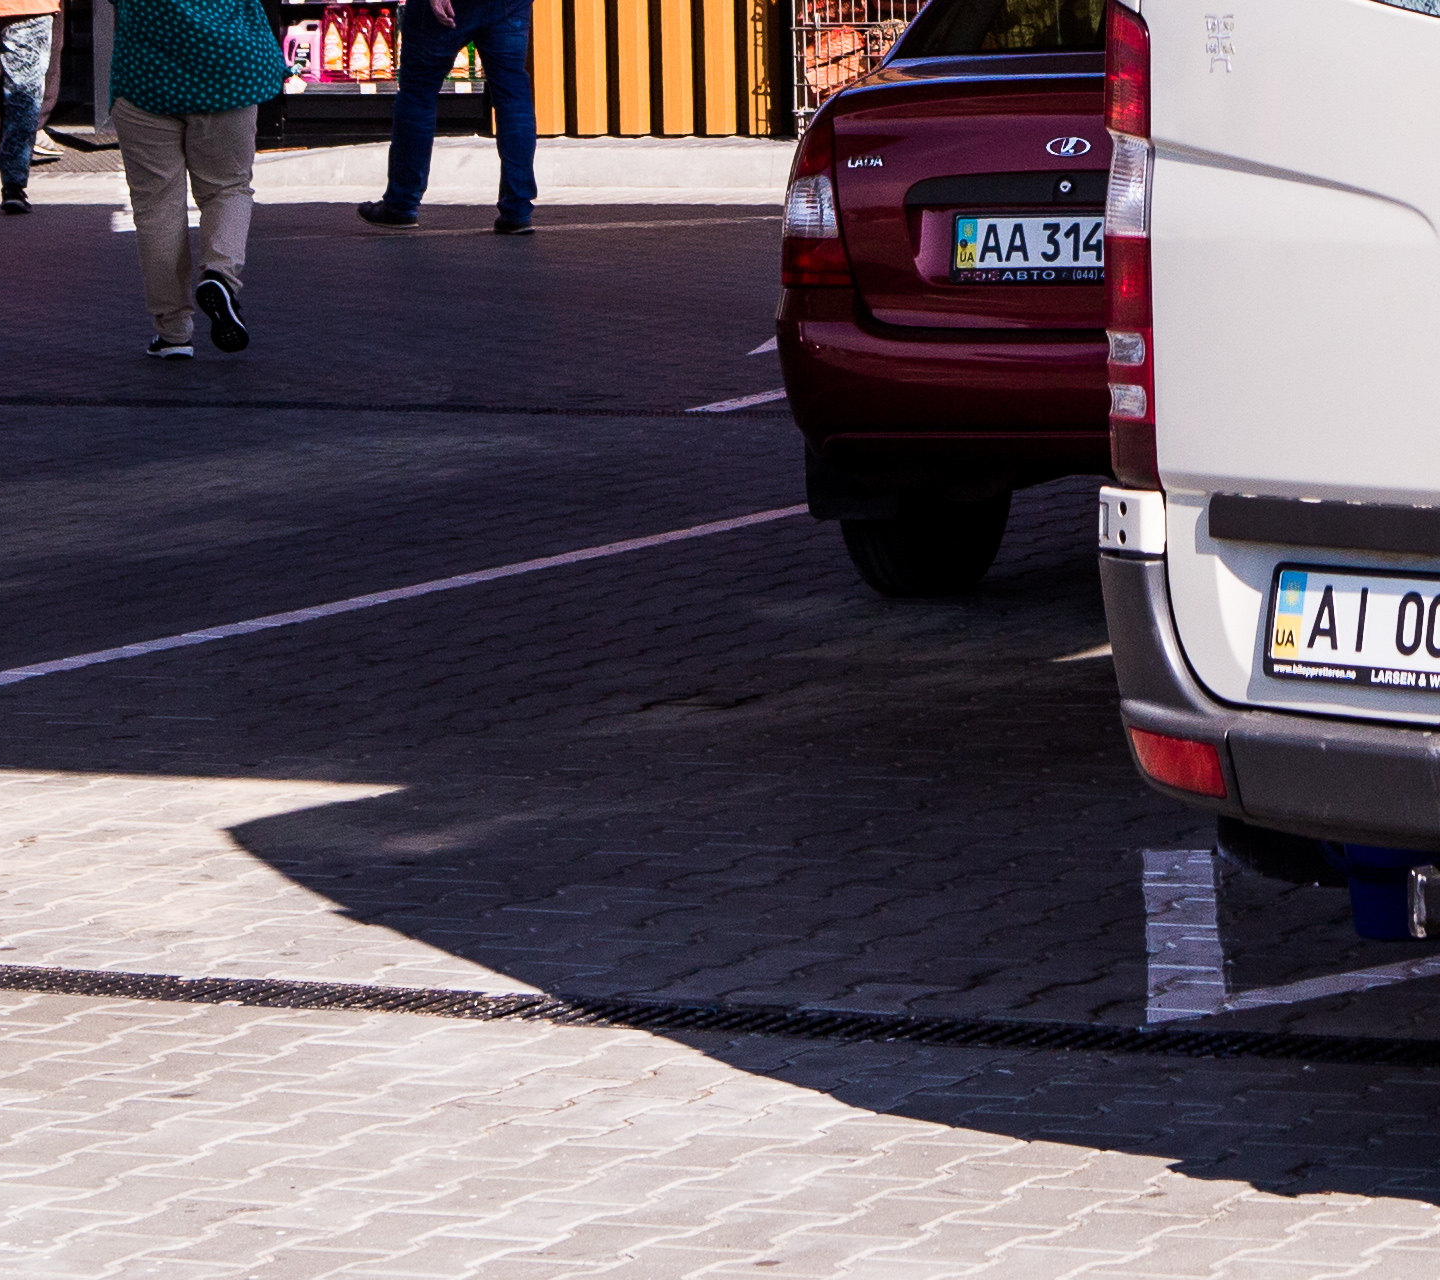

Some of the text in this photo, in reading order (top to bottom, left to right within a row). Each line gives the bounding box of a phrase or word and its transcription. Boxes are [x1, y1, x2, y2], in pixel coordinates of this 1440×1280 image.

[847, 155, 884, 169] LADA
[978, 222, 1030, 263] AA
[959, 251, 975, 263] UA
[1274, 627, 1296, 648] UA
[1370, 668, 1416, 687] LARSEN
[1417, 673, 1427, 688] &
